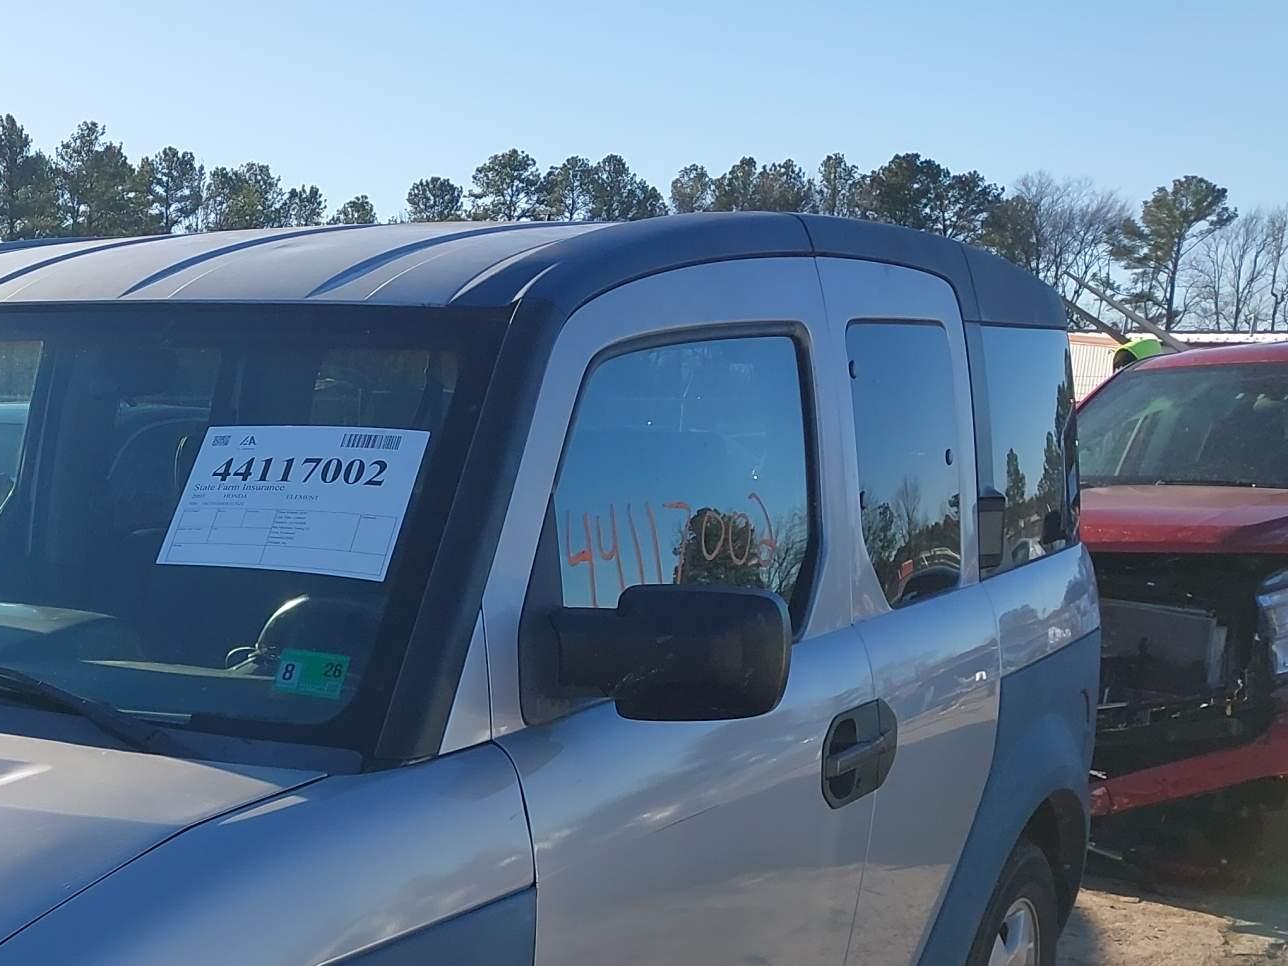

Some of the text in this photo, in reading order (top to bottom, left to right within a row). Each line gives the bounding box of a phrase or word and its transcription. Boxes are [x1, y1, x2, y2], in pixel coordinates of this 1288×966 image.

[212, 456, 388, 486] 44117002
[194, 483, 286, 492] State Farm Insurance
[282, 663, 296, 681] 8
[323, 662, 344, 678] 26
